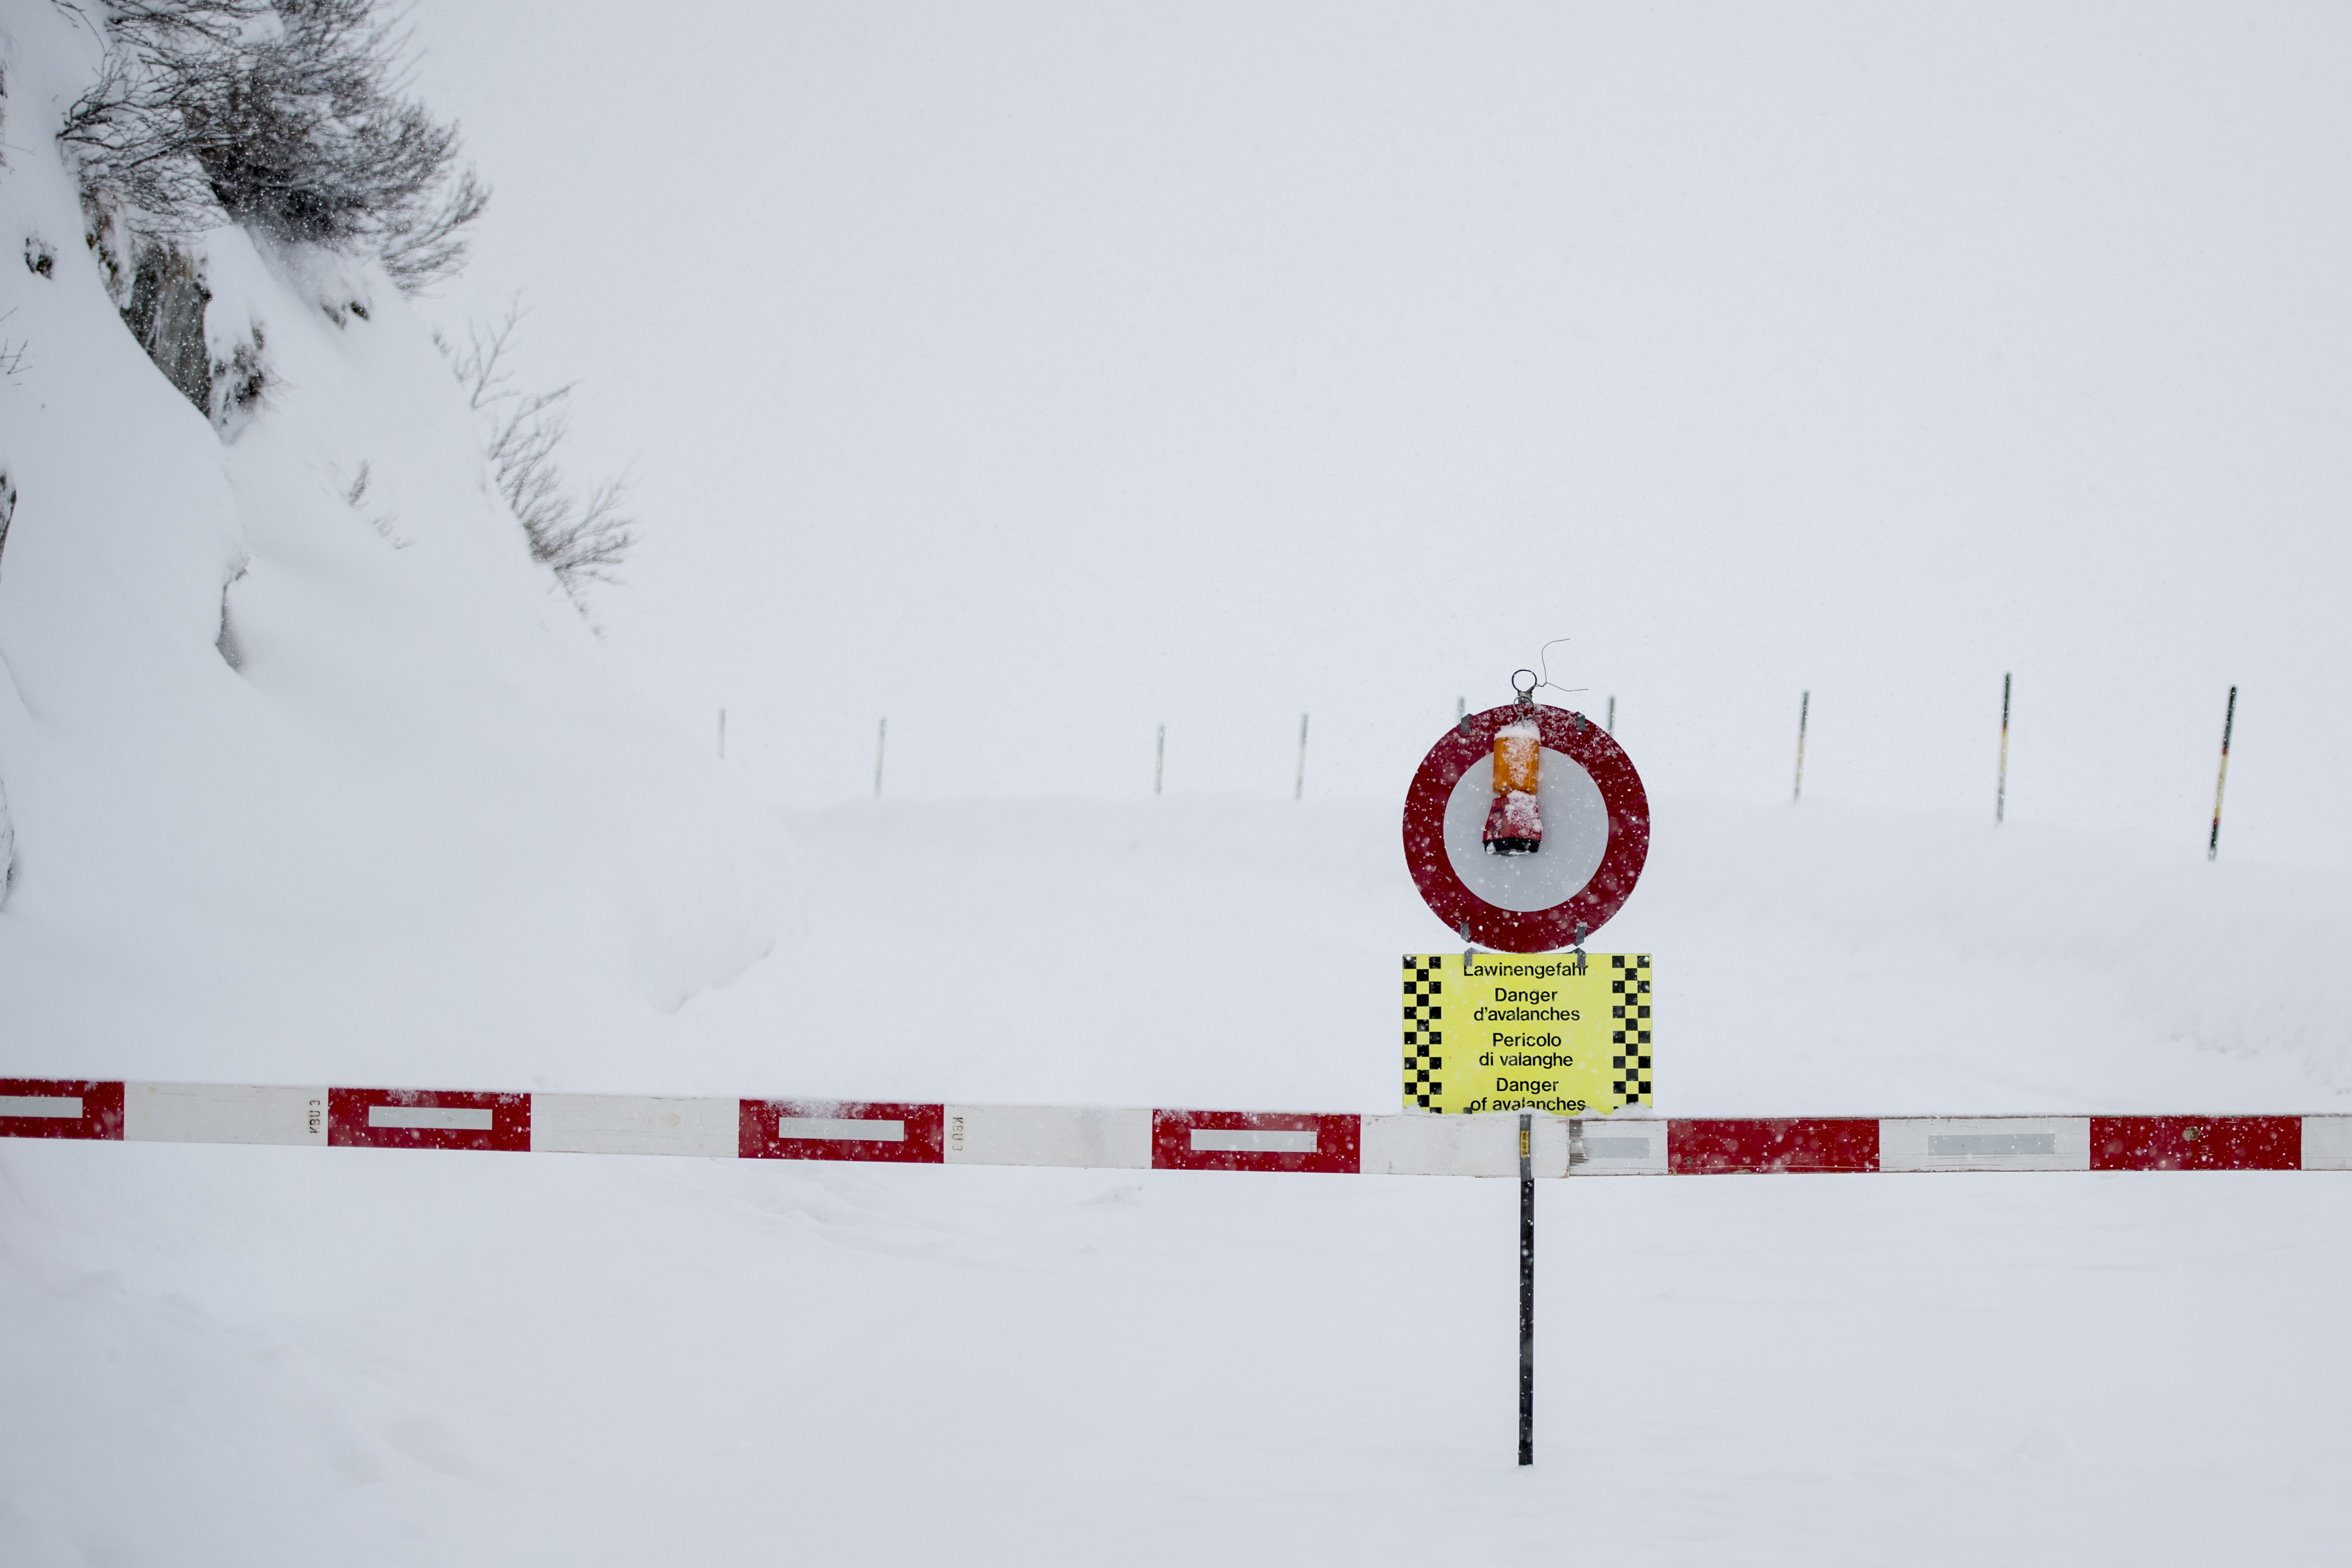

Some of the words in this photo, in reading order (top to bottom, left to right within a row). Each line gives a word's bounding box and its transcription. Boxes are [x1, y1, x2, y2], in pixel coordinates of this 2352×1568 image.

[1464, 962, 1588, 978] Lawinengefahr
[1495, 988, 1558, 1004] Danger
[1473, 1007, 1580, 1021] d’avalanches
[1493, 1033, 1561, 1047] Pericolo
[1479, 1052, 1494, 1066] di
[1500, 1052, 1573, 1069] valanghe
[1496, 1078, 1559, 1094] Danger
[1470, 1097, 1487, 1111] of
[309, 1110, 320, 1133] KBU
[952, 1117, 963, 1140] KBU
